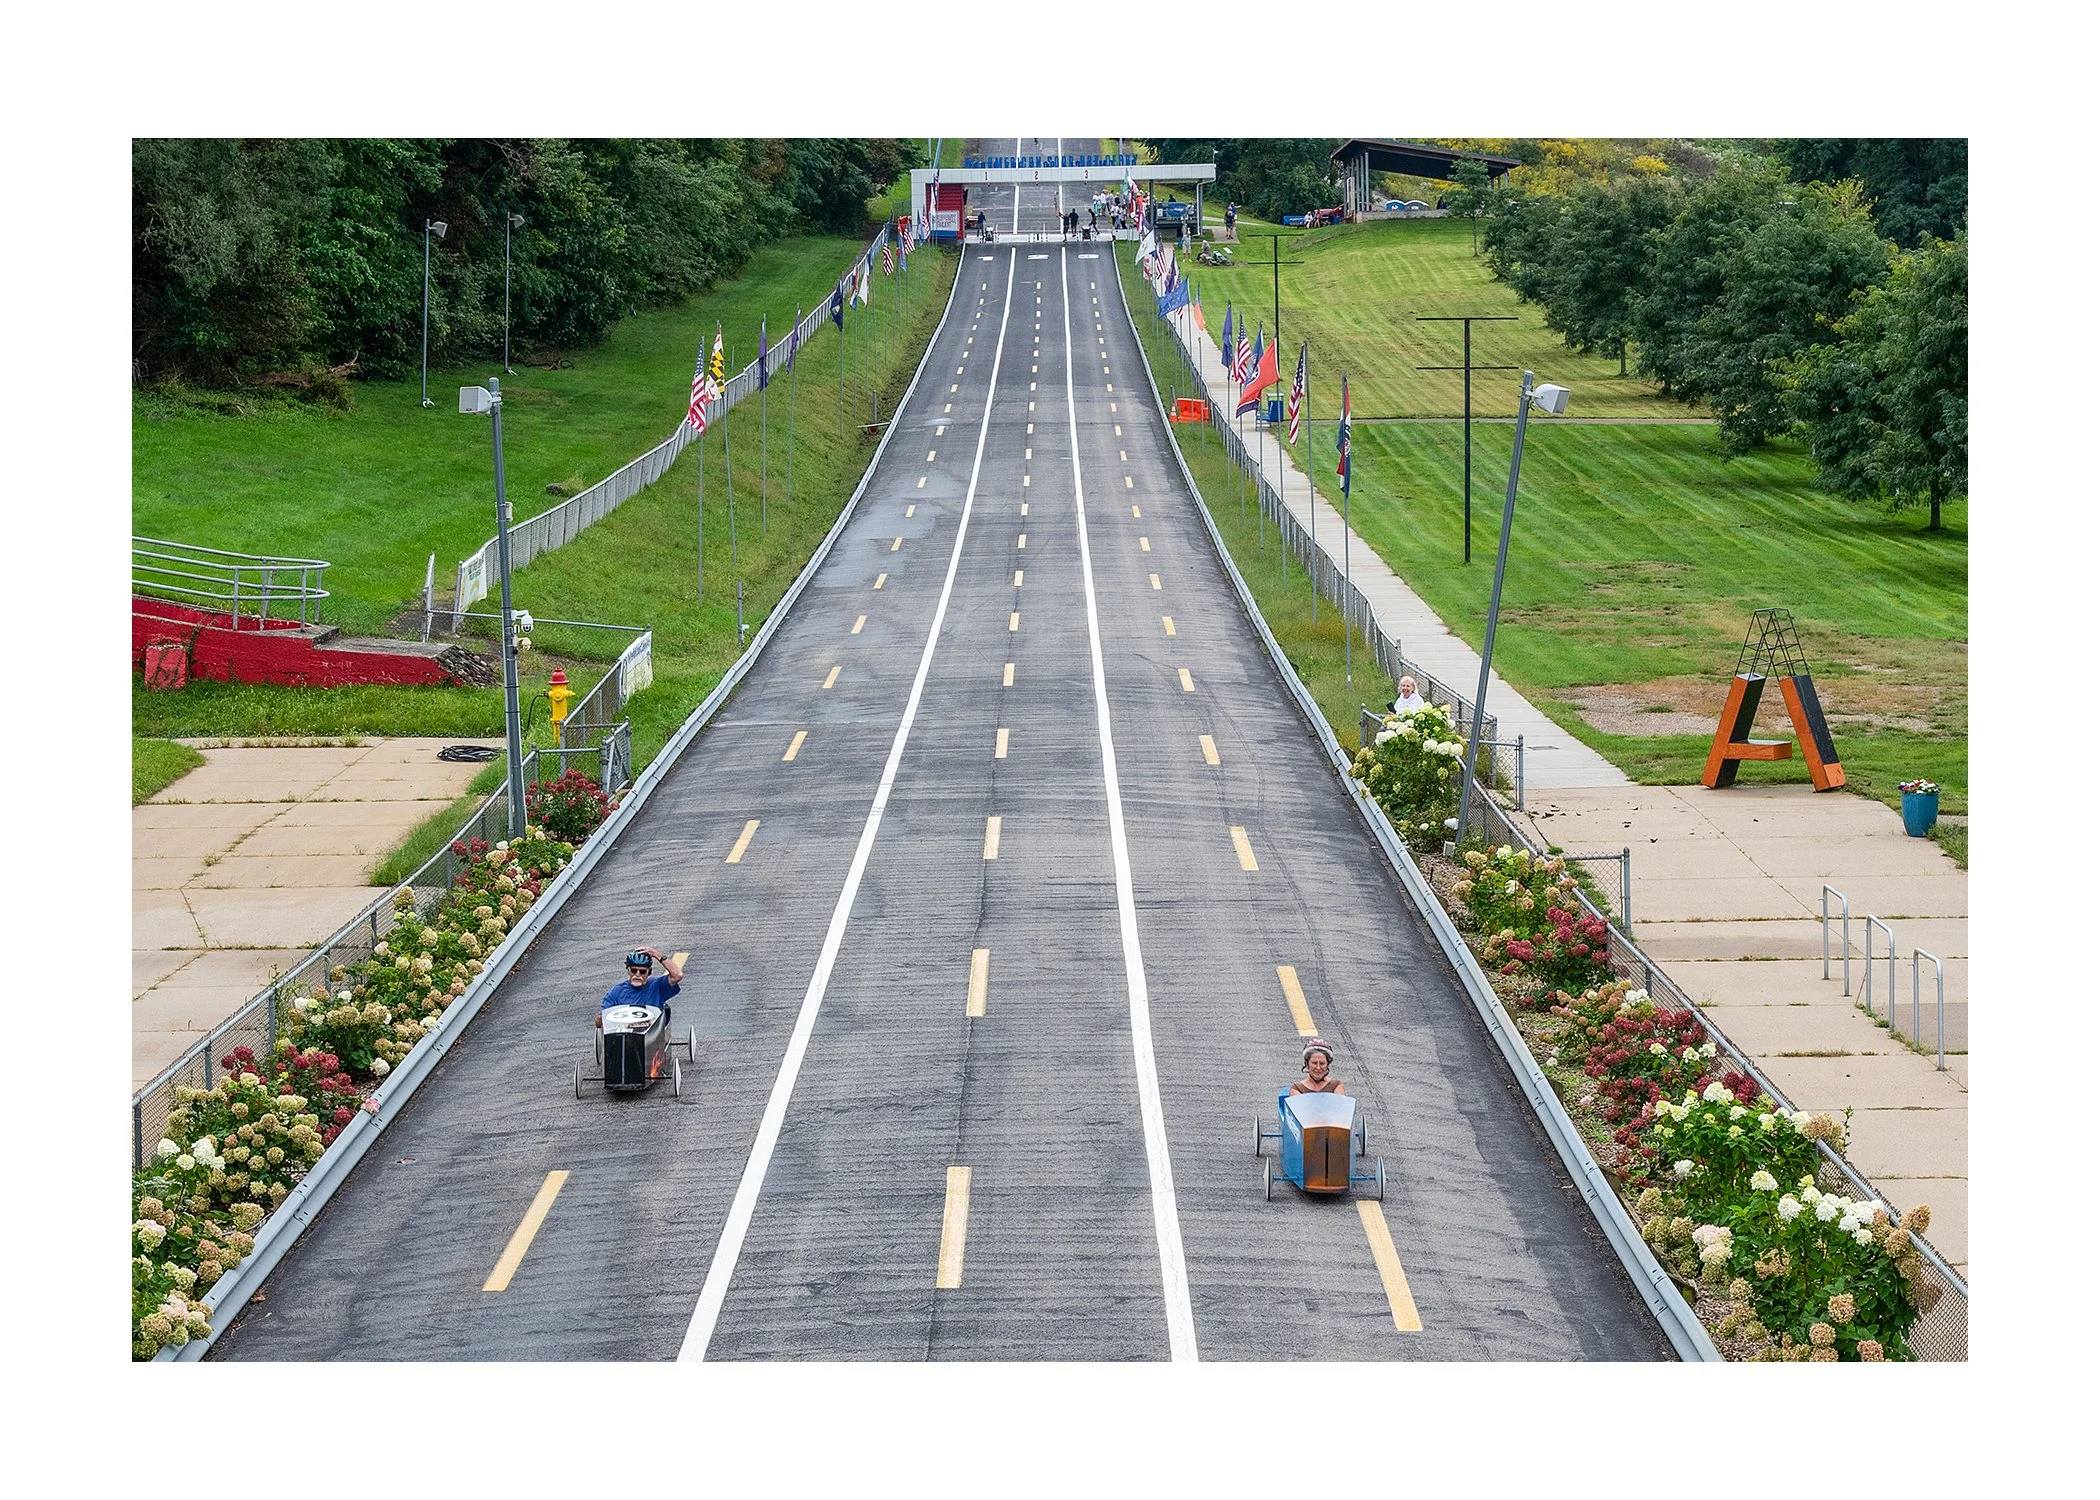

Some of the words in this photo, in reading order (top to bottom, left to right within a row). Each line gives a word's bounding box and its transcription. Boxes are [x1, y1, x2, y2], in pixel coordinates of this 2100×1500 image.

[984, 171, 988, 181] 1
[1034, 170, 1039, 180] 2
[1084, 169, 1089, 179] 3
[612, 1010, 649, 1019] 59
